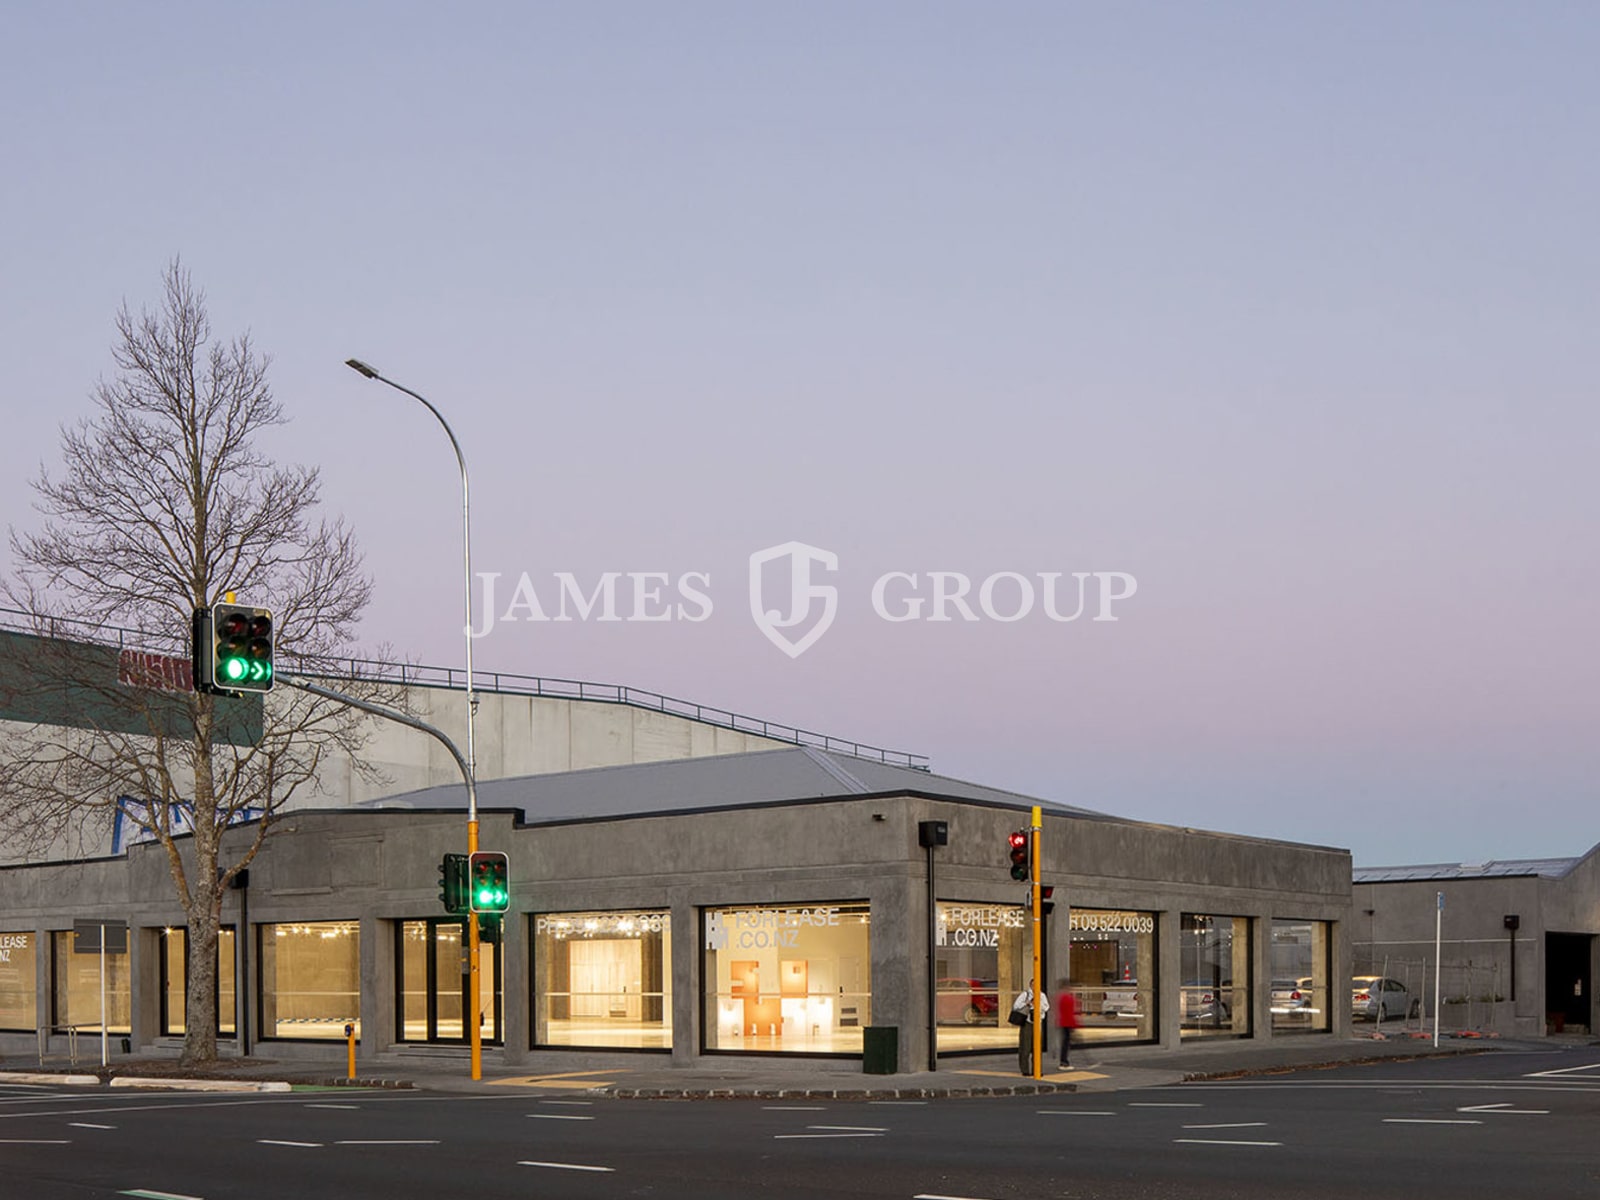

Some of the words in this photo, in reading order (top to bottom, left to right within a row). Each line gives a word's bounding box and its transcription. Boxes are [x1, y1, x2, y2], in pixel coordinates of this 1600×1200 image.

[736, 908, 840, 928] FORLEASE
[952, 907, 1025, 928] FORLEASE
[1081, 914, 1098, 931] 09
[1100, 915, 1121, 932] 522
[1123, 917, 1154, 934] 0039
